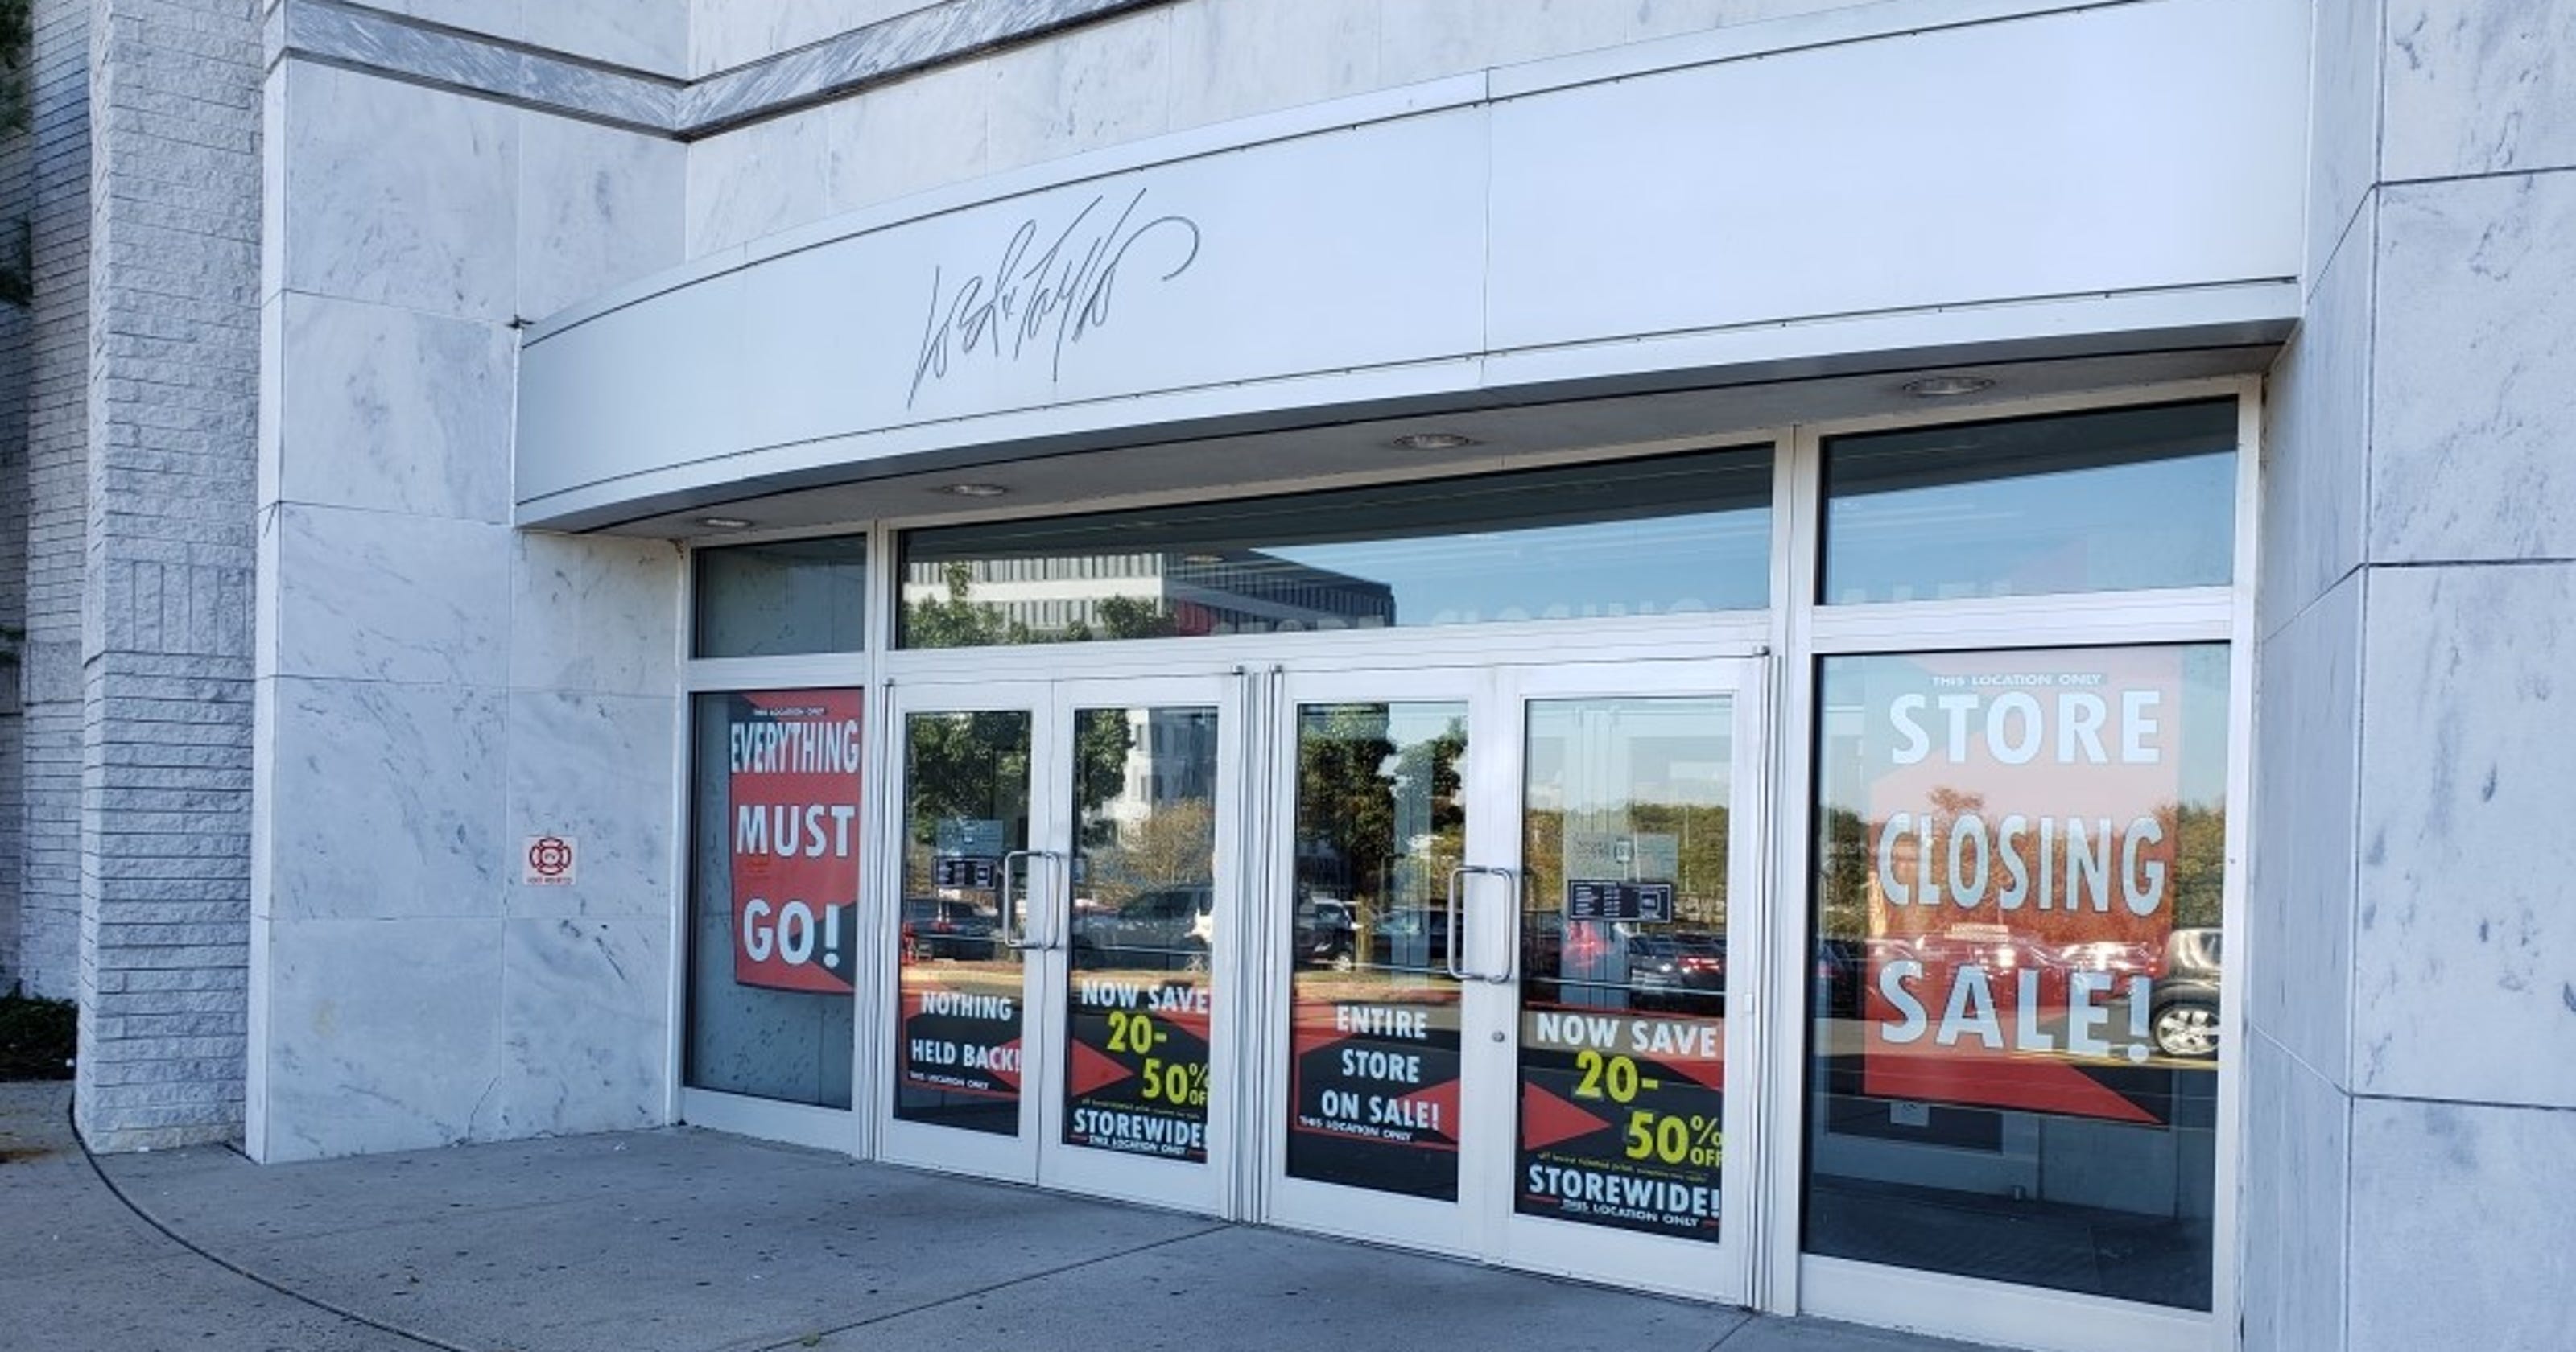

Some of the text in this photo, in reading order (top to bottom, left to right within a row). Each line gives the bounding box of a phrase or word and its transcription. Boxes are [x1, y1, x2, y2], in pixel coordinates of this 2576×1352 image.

[1932, 673, 2103, 687] THIS LOCATION ONLY
[730, 719, 860, 774] EVERYTHING
[1889, 690, 2161, 765] STORE
[736, 804, 855, 857] MUST
[1876, 810, 2167, 917] CLOSING
[743, 897, 840, 969] GO!
[920, 991, 1013, 1021] NOTHING
[1081, 979, 1209, 1015] NOW SAVE
[1878, 959, 2154, 1065] SALE!
[1106, 1010, 1167, 1055] 20-
[1336, 1004, 1428, 1040] ENTIRE
[1536, 1012, 1718, 1058] NOW SAVE
[911, 1038, 1021, 1074] HELD BACK!
[1342, 1048, 1421, 1084] STORE
[1575, 1049, 1660, 1103] 20-
[1299, 1115, 1414, 1142] THIS LOCATION ONLY
[1321, 1088, 1439, 1131] ON SALE!
[1529, 1164, 1720, 1219] STOREWIDE!
[1593, 1203, 1659, 1222] LOCATION
[1662, 1213, 1700, 1227] ONLY
